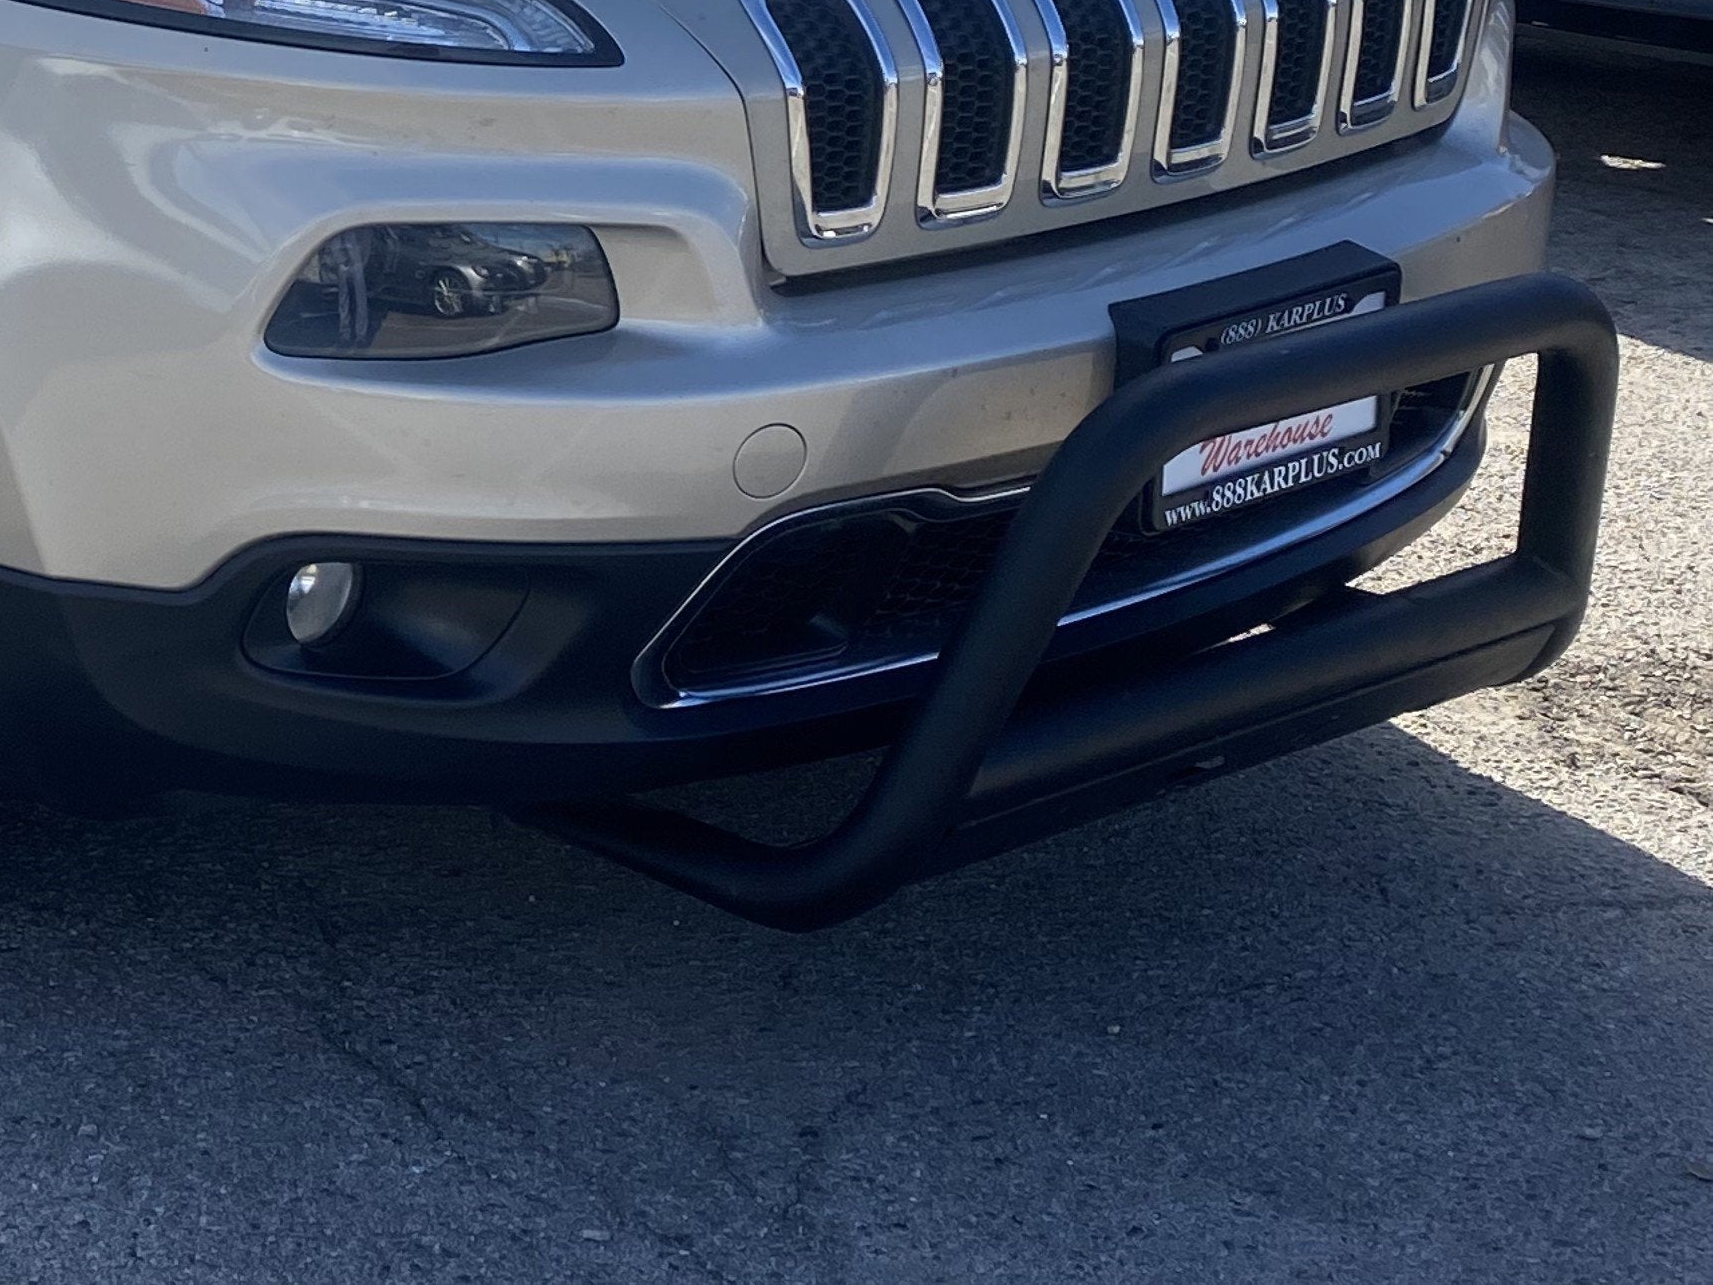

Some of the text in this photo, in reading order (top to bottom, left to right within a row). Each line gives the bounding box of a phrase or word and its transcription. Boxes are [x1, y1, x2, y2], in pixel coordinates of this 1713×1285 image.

[1220, 292, 1348, 345] (888) KARPLUS
[1198, 412, 1334, 477] Warehouse
